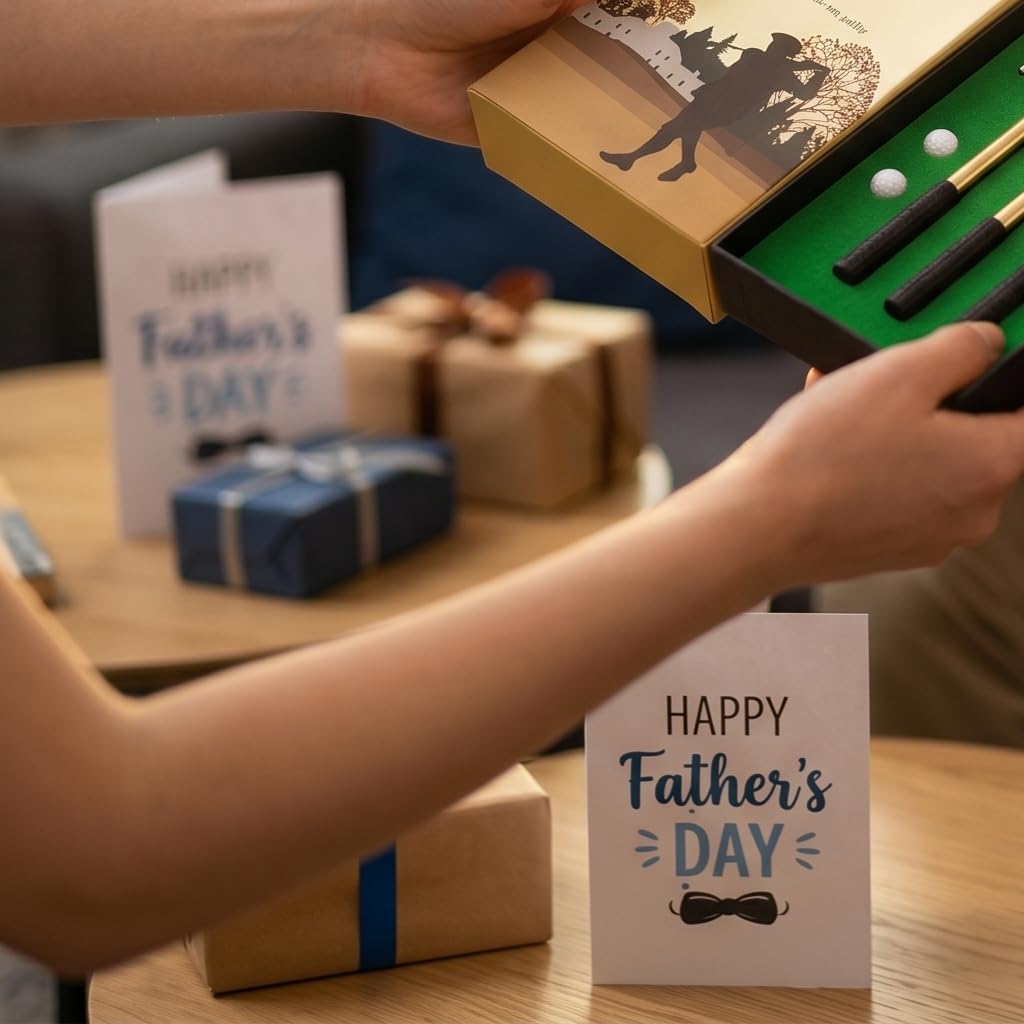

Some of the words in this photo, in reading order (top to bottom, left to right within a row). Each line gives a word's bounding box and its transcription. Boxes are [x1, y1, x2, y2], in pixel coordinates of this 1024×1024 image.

[666, 696, 788, 736] HAPPY
[619, 748, 832, 813] Father's
[675, 823, 784, 878] DAY
